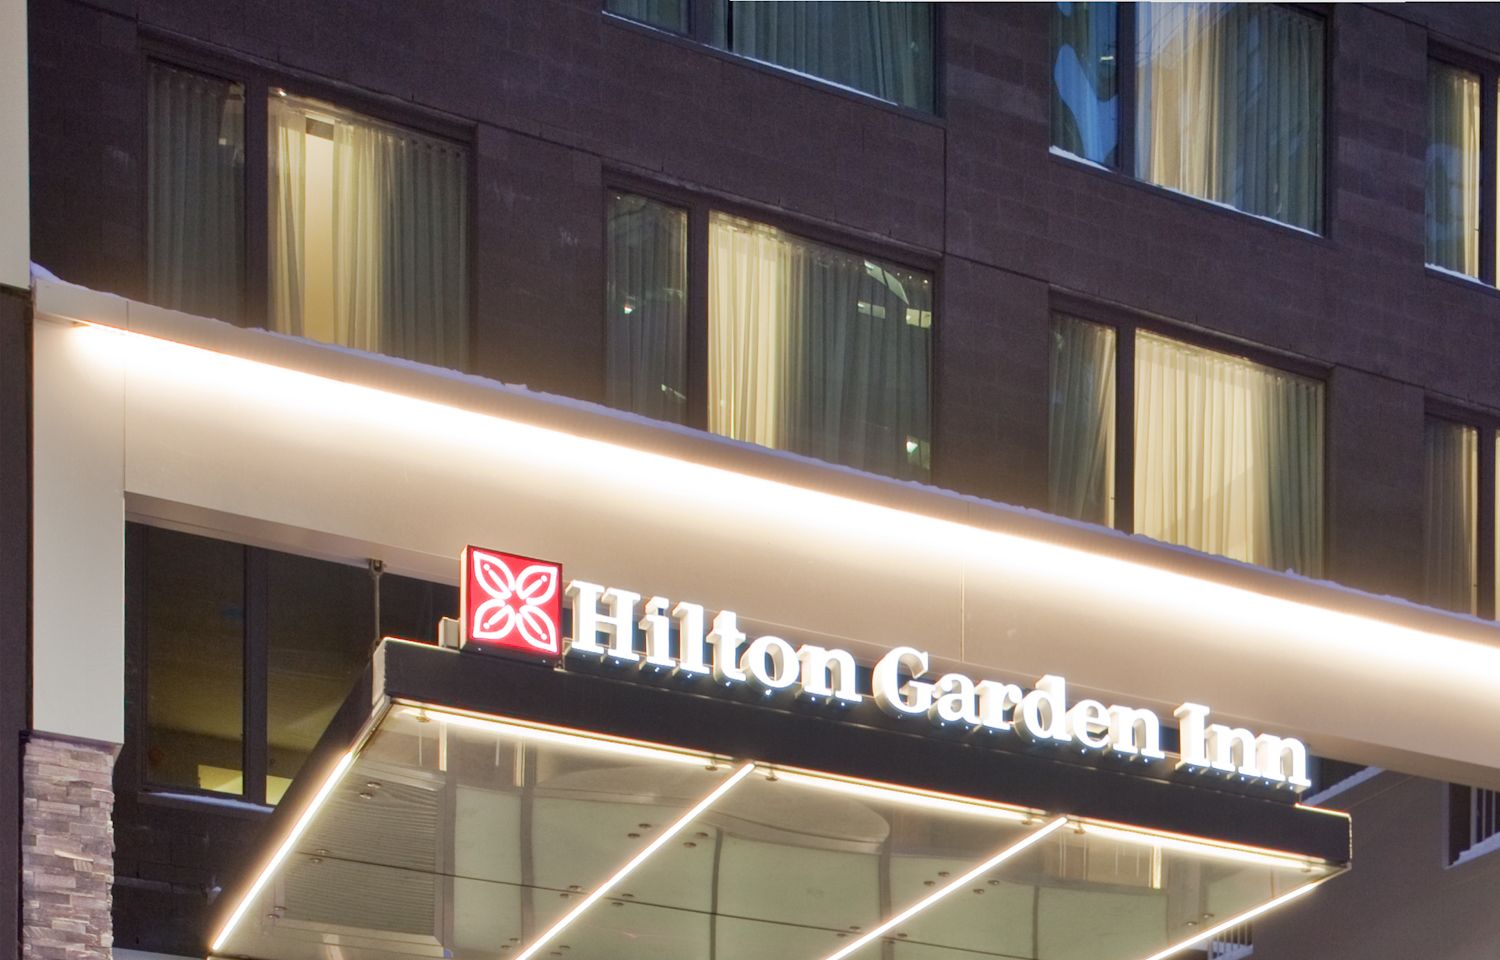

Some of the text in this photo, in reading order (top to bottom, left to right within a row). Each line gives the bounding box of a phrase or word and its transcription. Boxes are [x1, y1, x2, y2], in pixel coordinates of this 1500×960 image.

[565, 580, 1312, 788] Hilton Garden Inn
